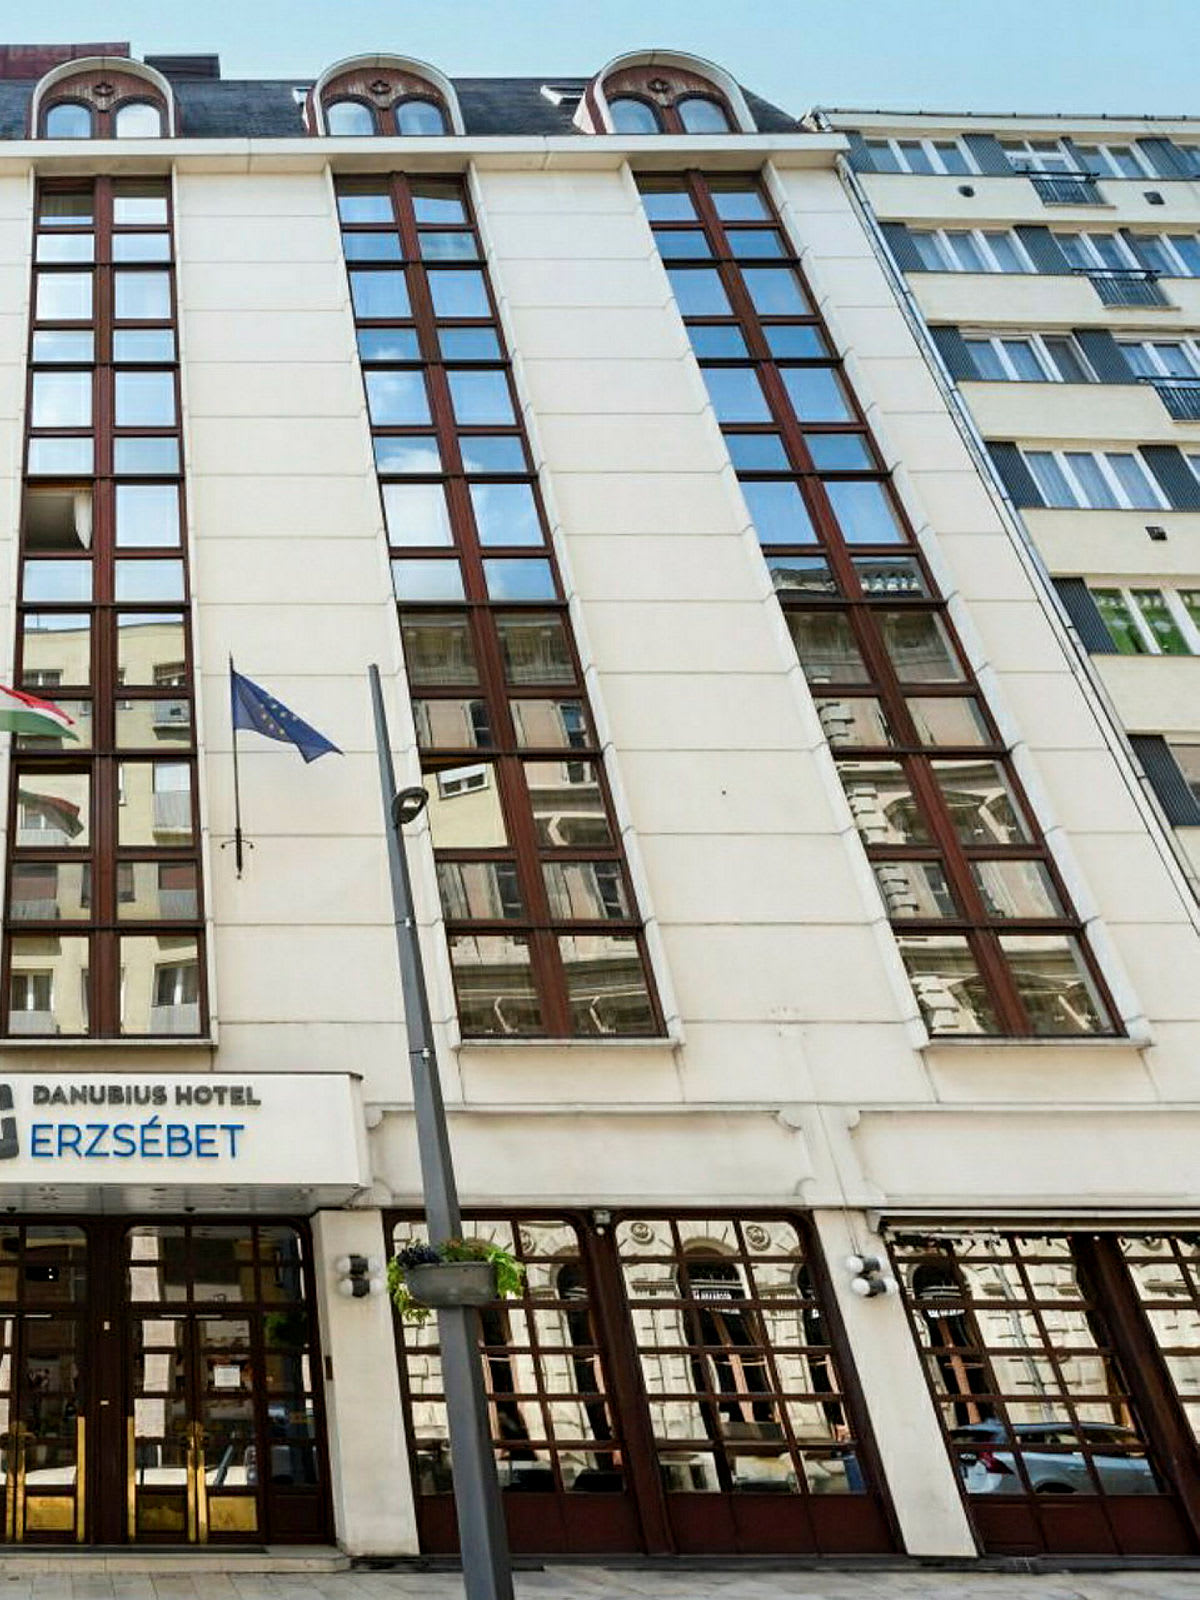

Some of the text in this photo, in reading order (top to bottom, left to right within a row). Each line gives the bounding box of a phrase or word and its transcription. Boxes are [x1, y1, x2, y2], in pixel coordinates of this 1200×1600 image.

[32, 1085, 262, 1106] DANUBIUS HOTEL
[30, 1115, 245, 1158] ERZSÉBET
